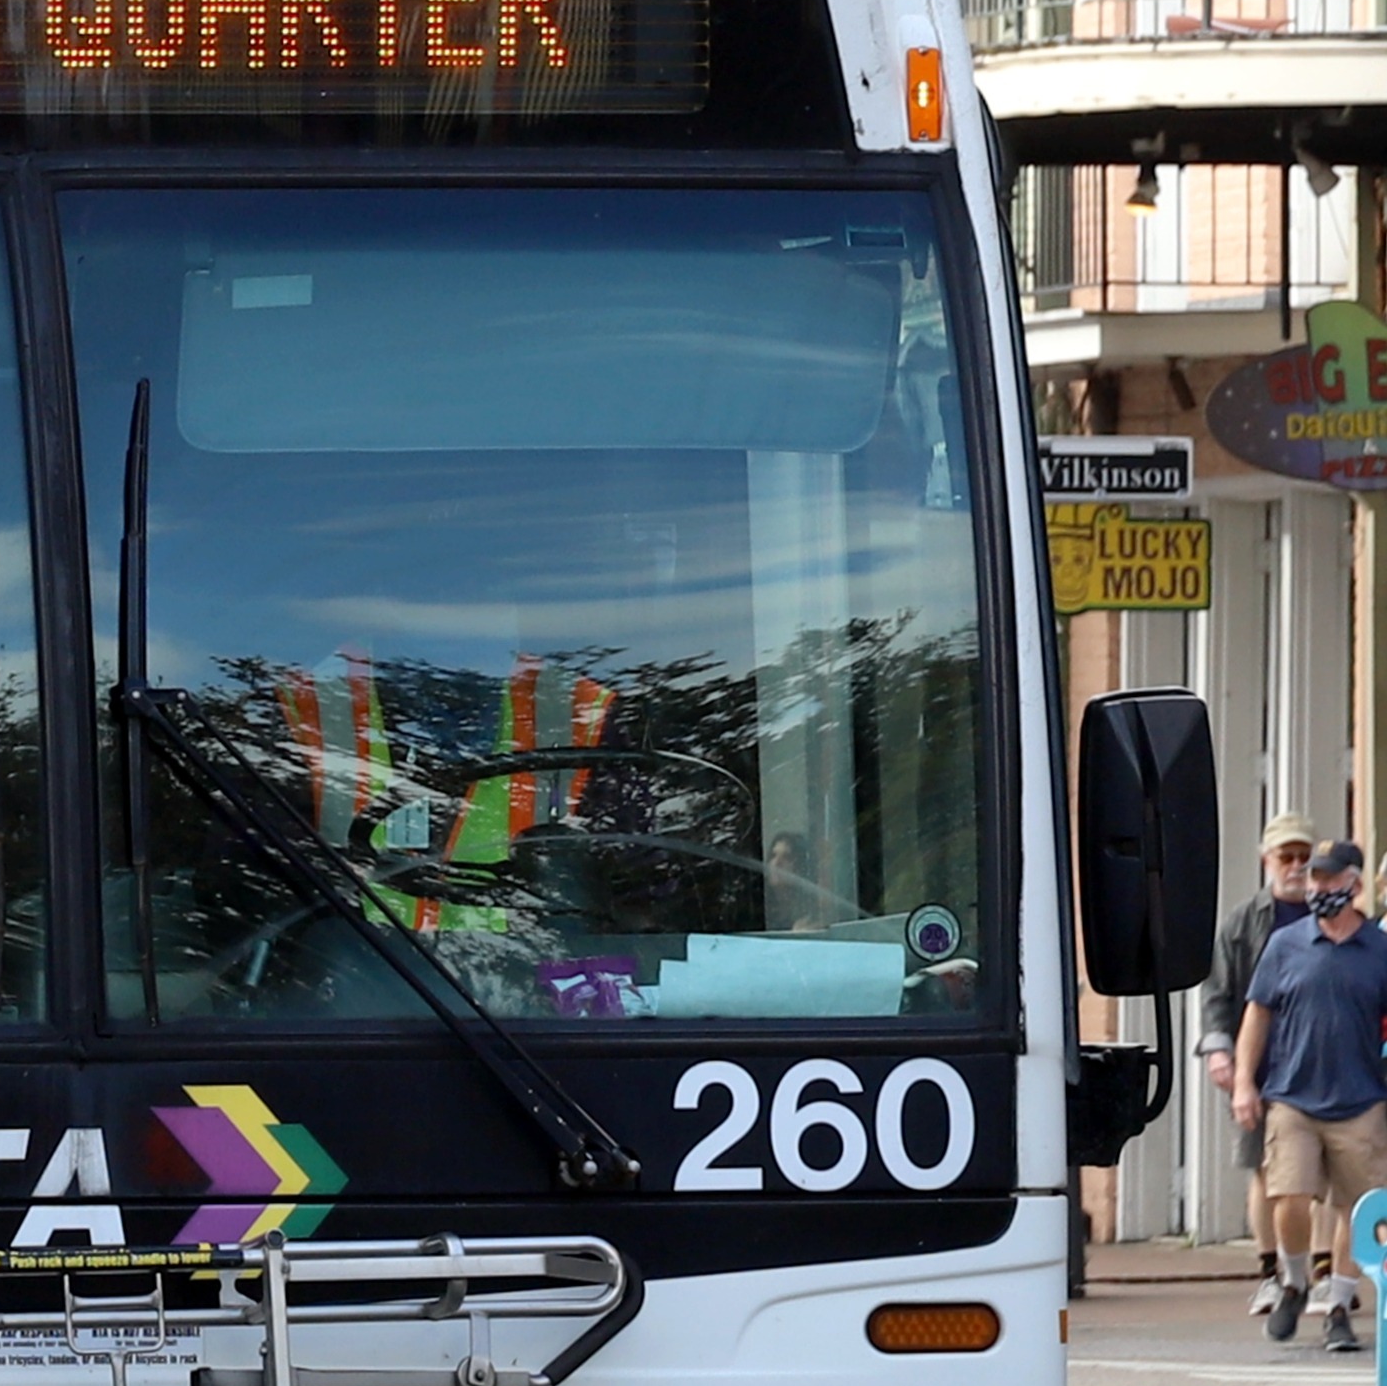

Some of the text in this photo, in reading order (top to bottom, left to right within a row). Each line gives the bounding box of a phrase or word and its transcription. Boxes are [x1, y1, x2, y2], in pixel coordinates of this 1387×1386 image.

[1265, 344, 1347, 406] BIG
[1098, 527, 1204, 560] LUCKY
[1102, 565, 1201, 601] MOJO
[673, 1056, 976, 1193] 260
[9, 1255, 36, 1269] Push
[38, 1255, 62, 1269] rack
[64, 1254, 84, 1268] and
[86, 1254, 128, 1269] squeeze
